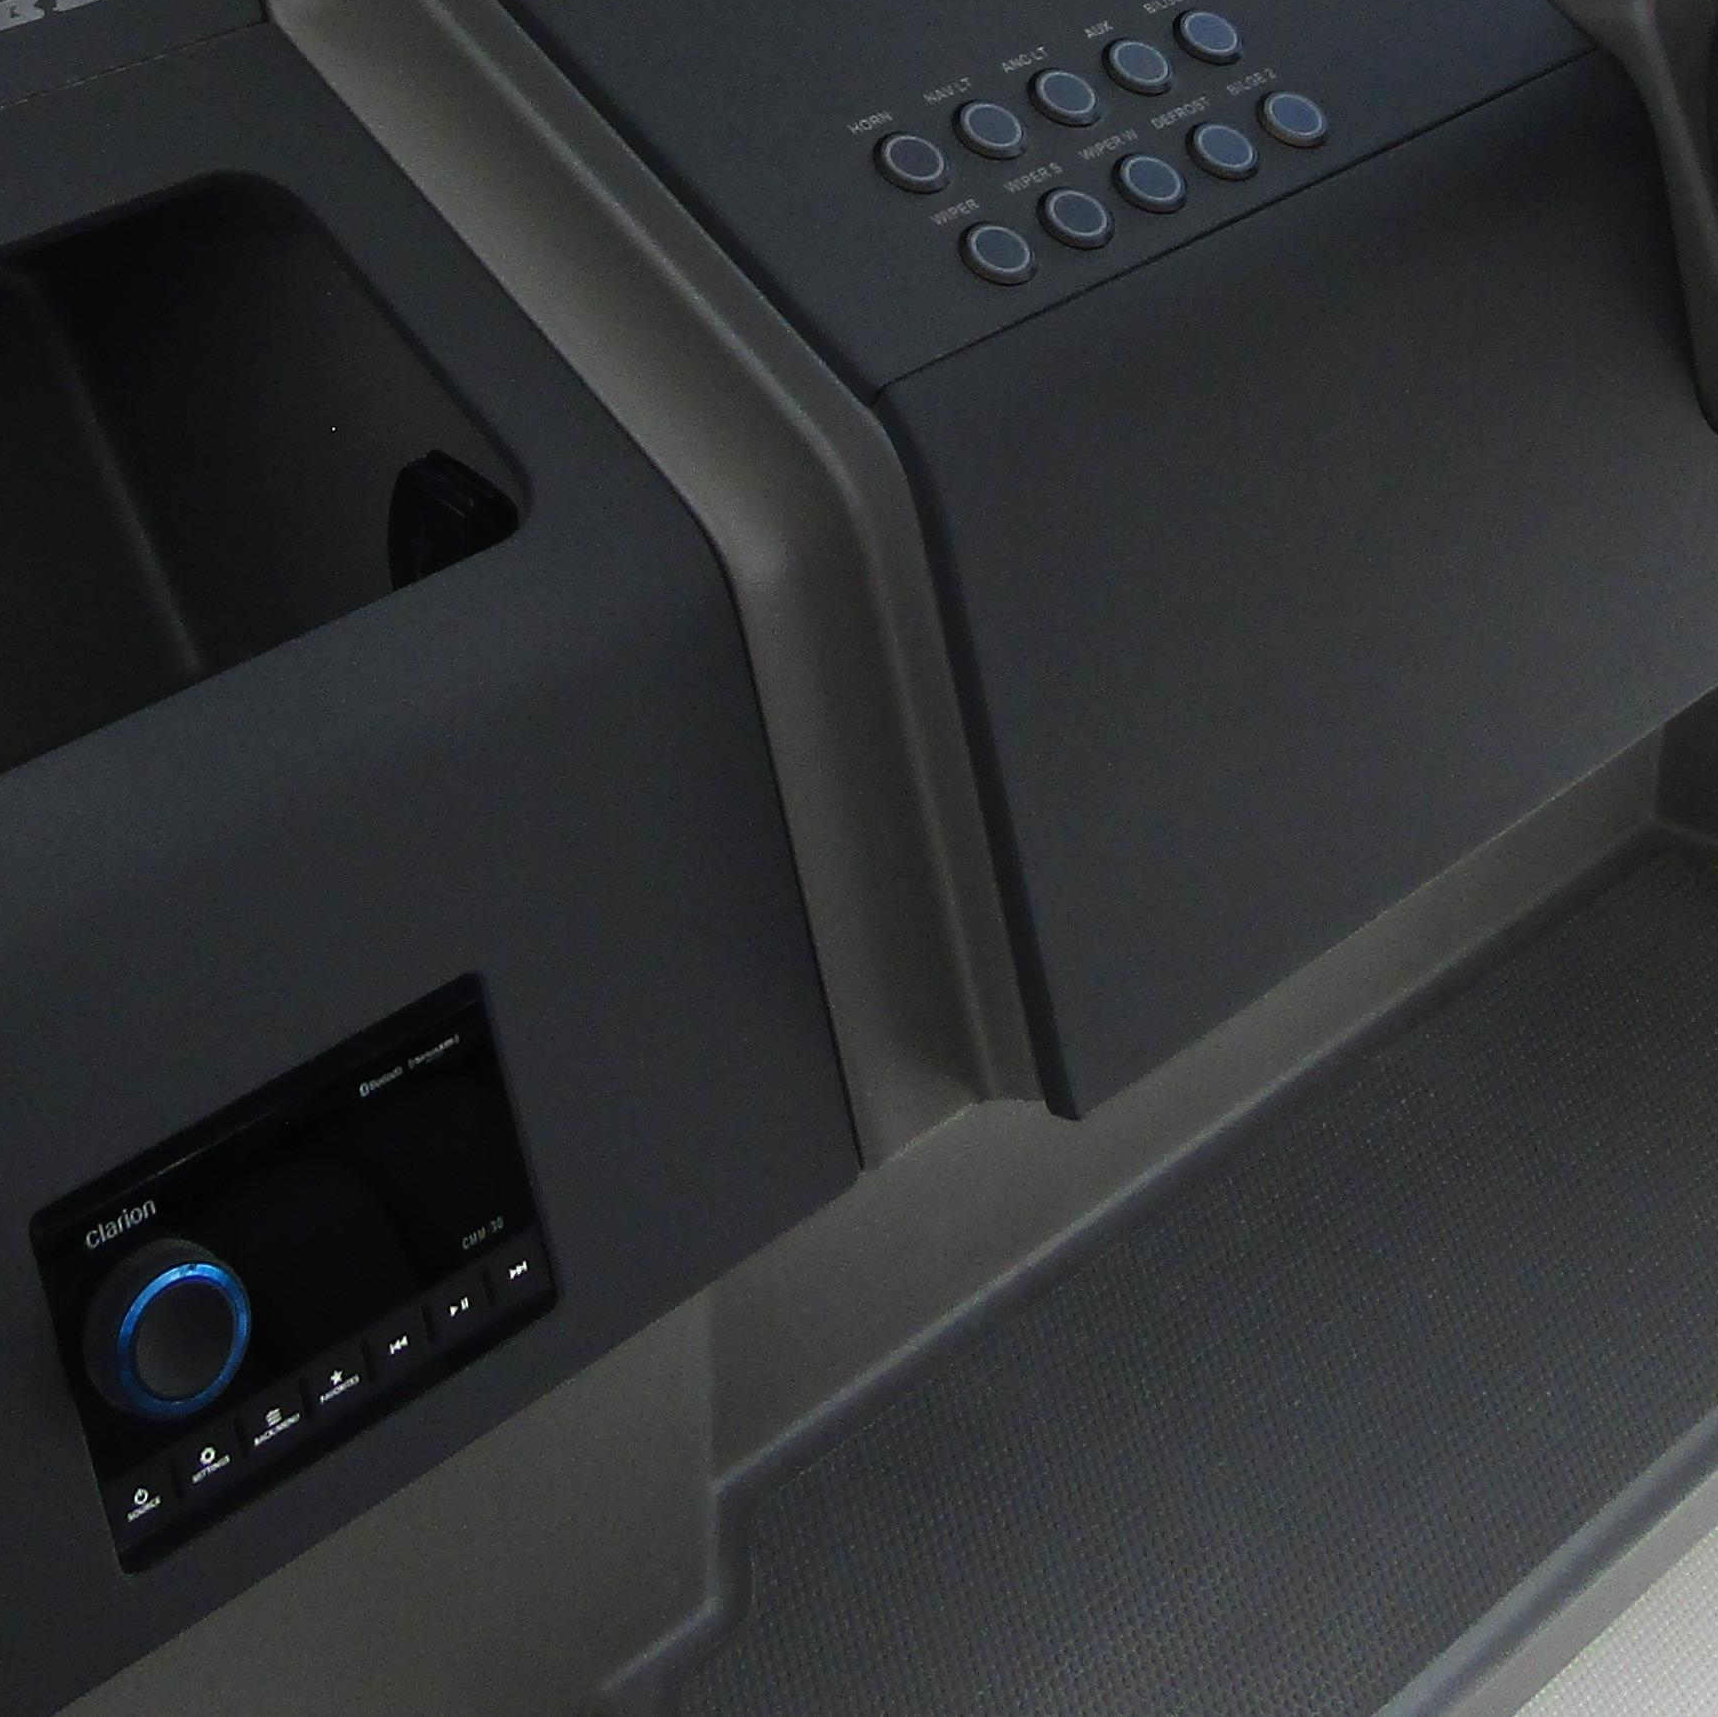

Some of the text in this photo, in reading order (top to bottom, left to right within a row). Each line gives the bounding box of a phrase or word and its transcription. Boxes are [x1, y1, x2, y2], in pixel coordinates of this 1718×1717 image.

[1084, 20, 1114, 38] AUX
[1001, 45, 1050, 73] ANC LT
[923, 77, 974, 105] NAV LT
[1226, 67, 1278, 97] BILGE 2
[846, 110, 894, 135] HORN
[1151, 96, 1212, 130] DEFROST
[1078, 134, 1124, 161] WIPER
[1003, 165, 1049, 194] WIPER
[931, 197, 980, 226] WIPER
[85, 1200, 156, 1249] clarion
